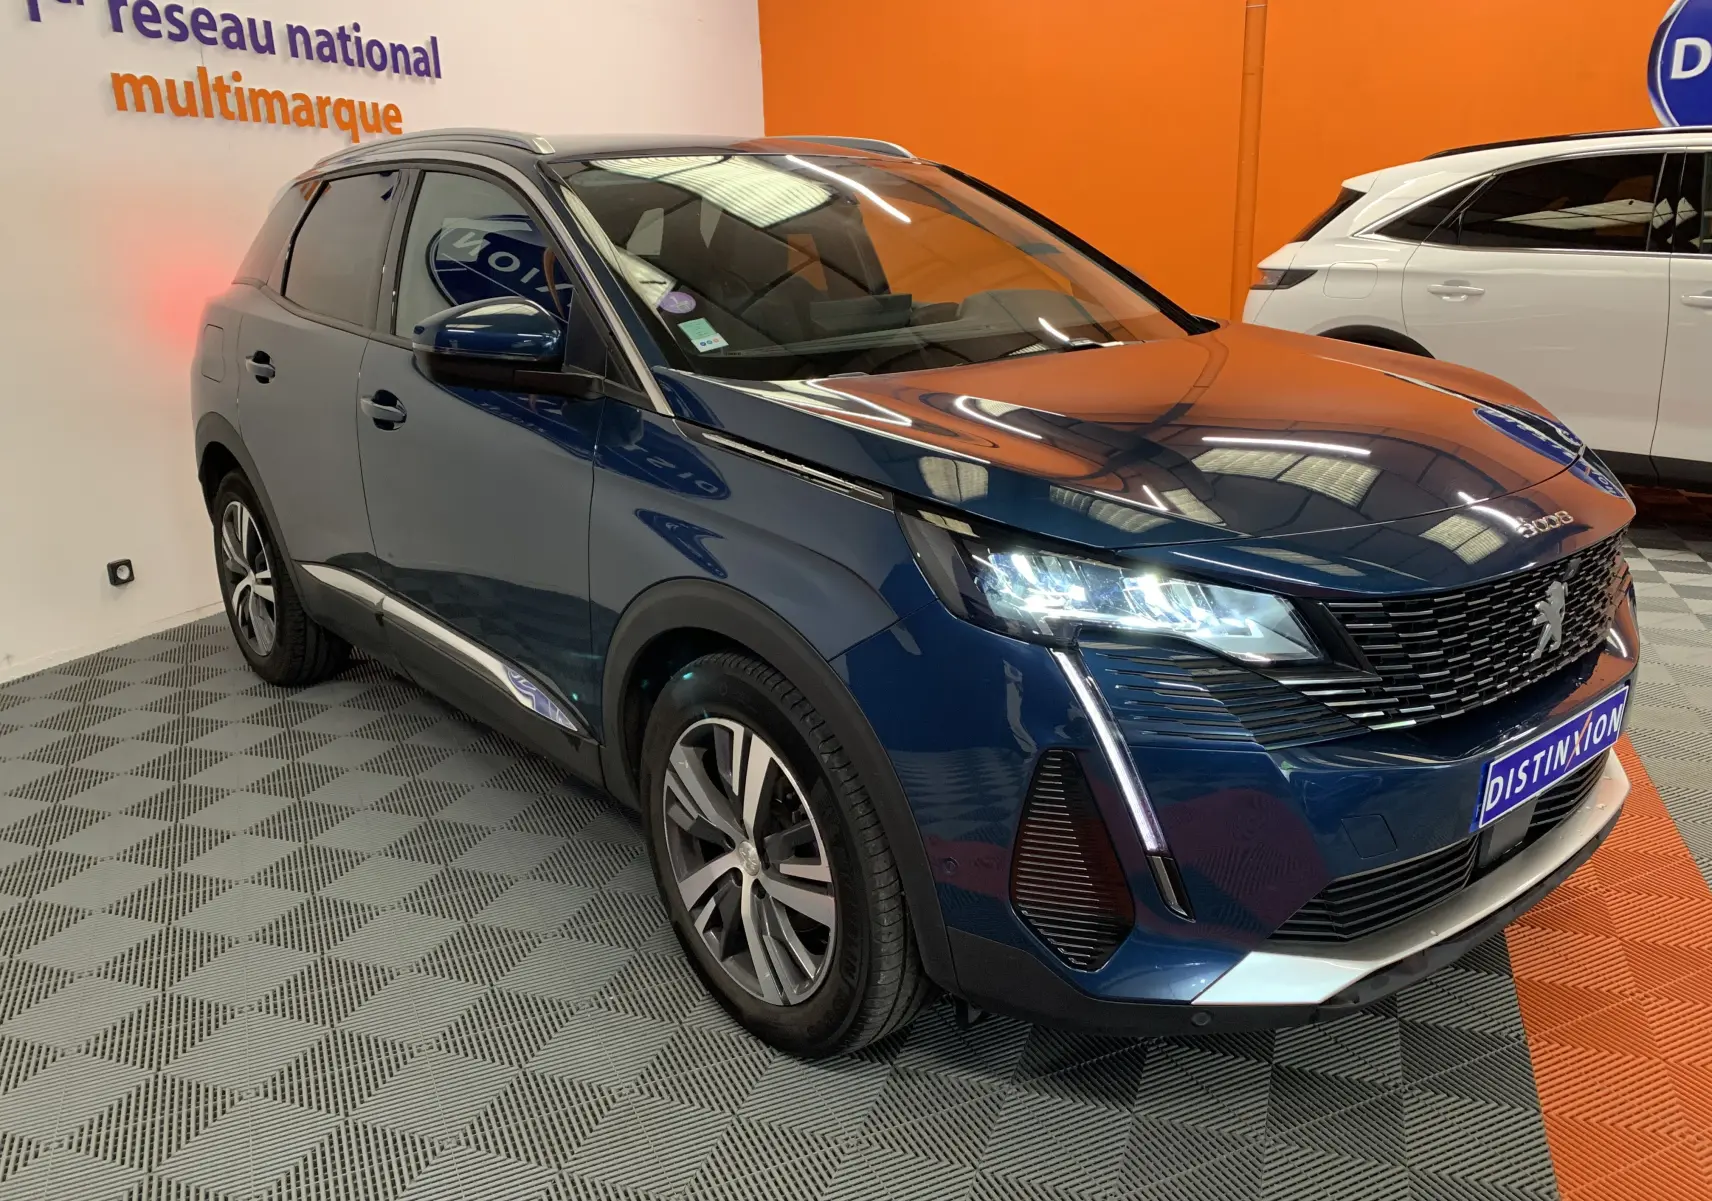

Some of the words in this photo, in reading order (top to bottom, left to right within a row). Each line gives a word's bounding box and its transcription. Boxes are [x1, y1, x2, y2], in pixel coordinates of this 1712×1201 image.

[286, 22, 441, 79] national
[1671, 37, 1712, 79] D
[111, 66, 403, 144] multimarque
[1485, 703, 1624, 812] DISTINXION
